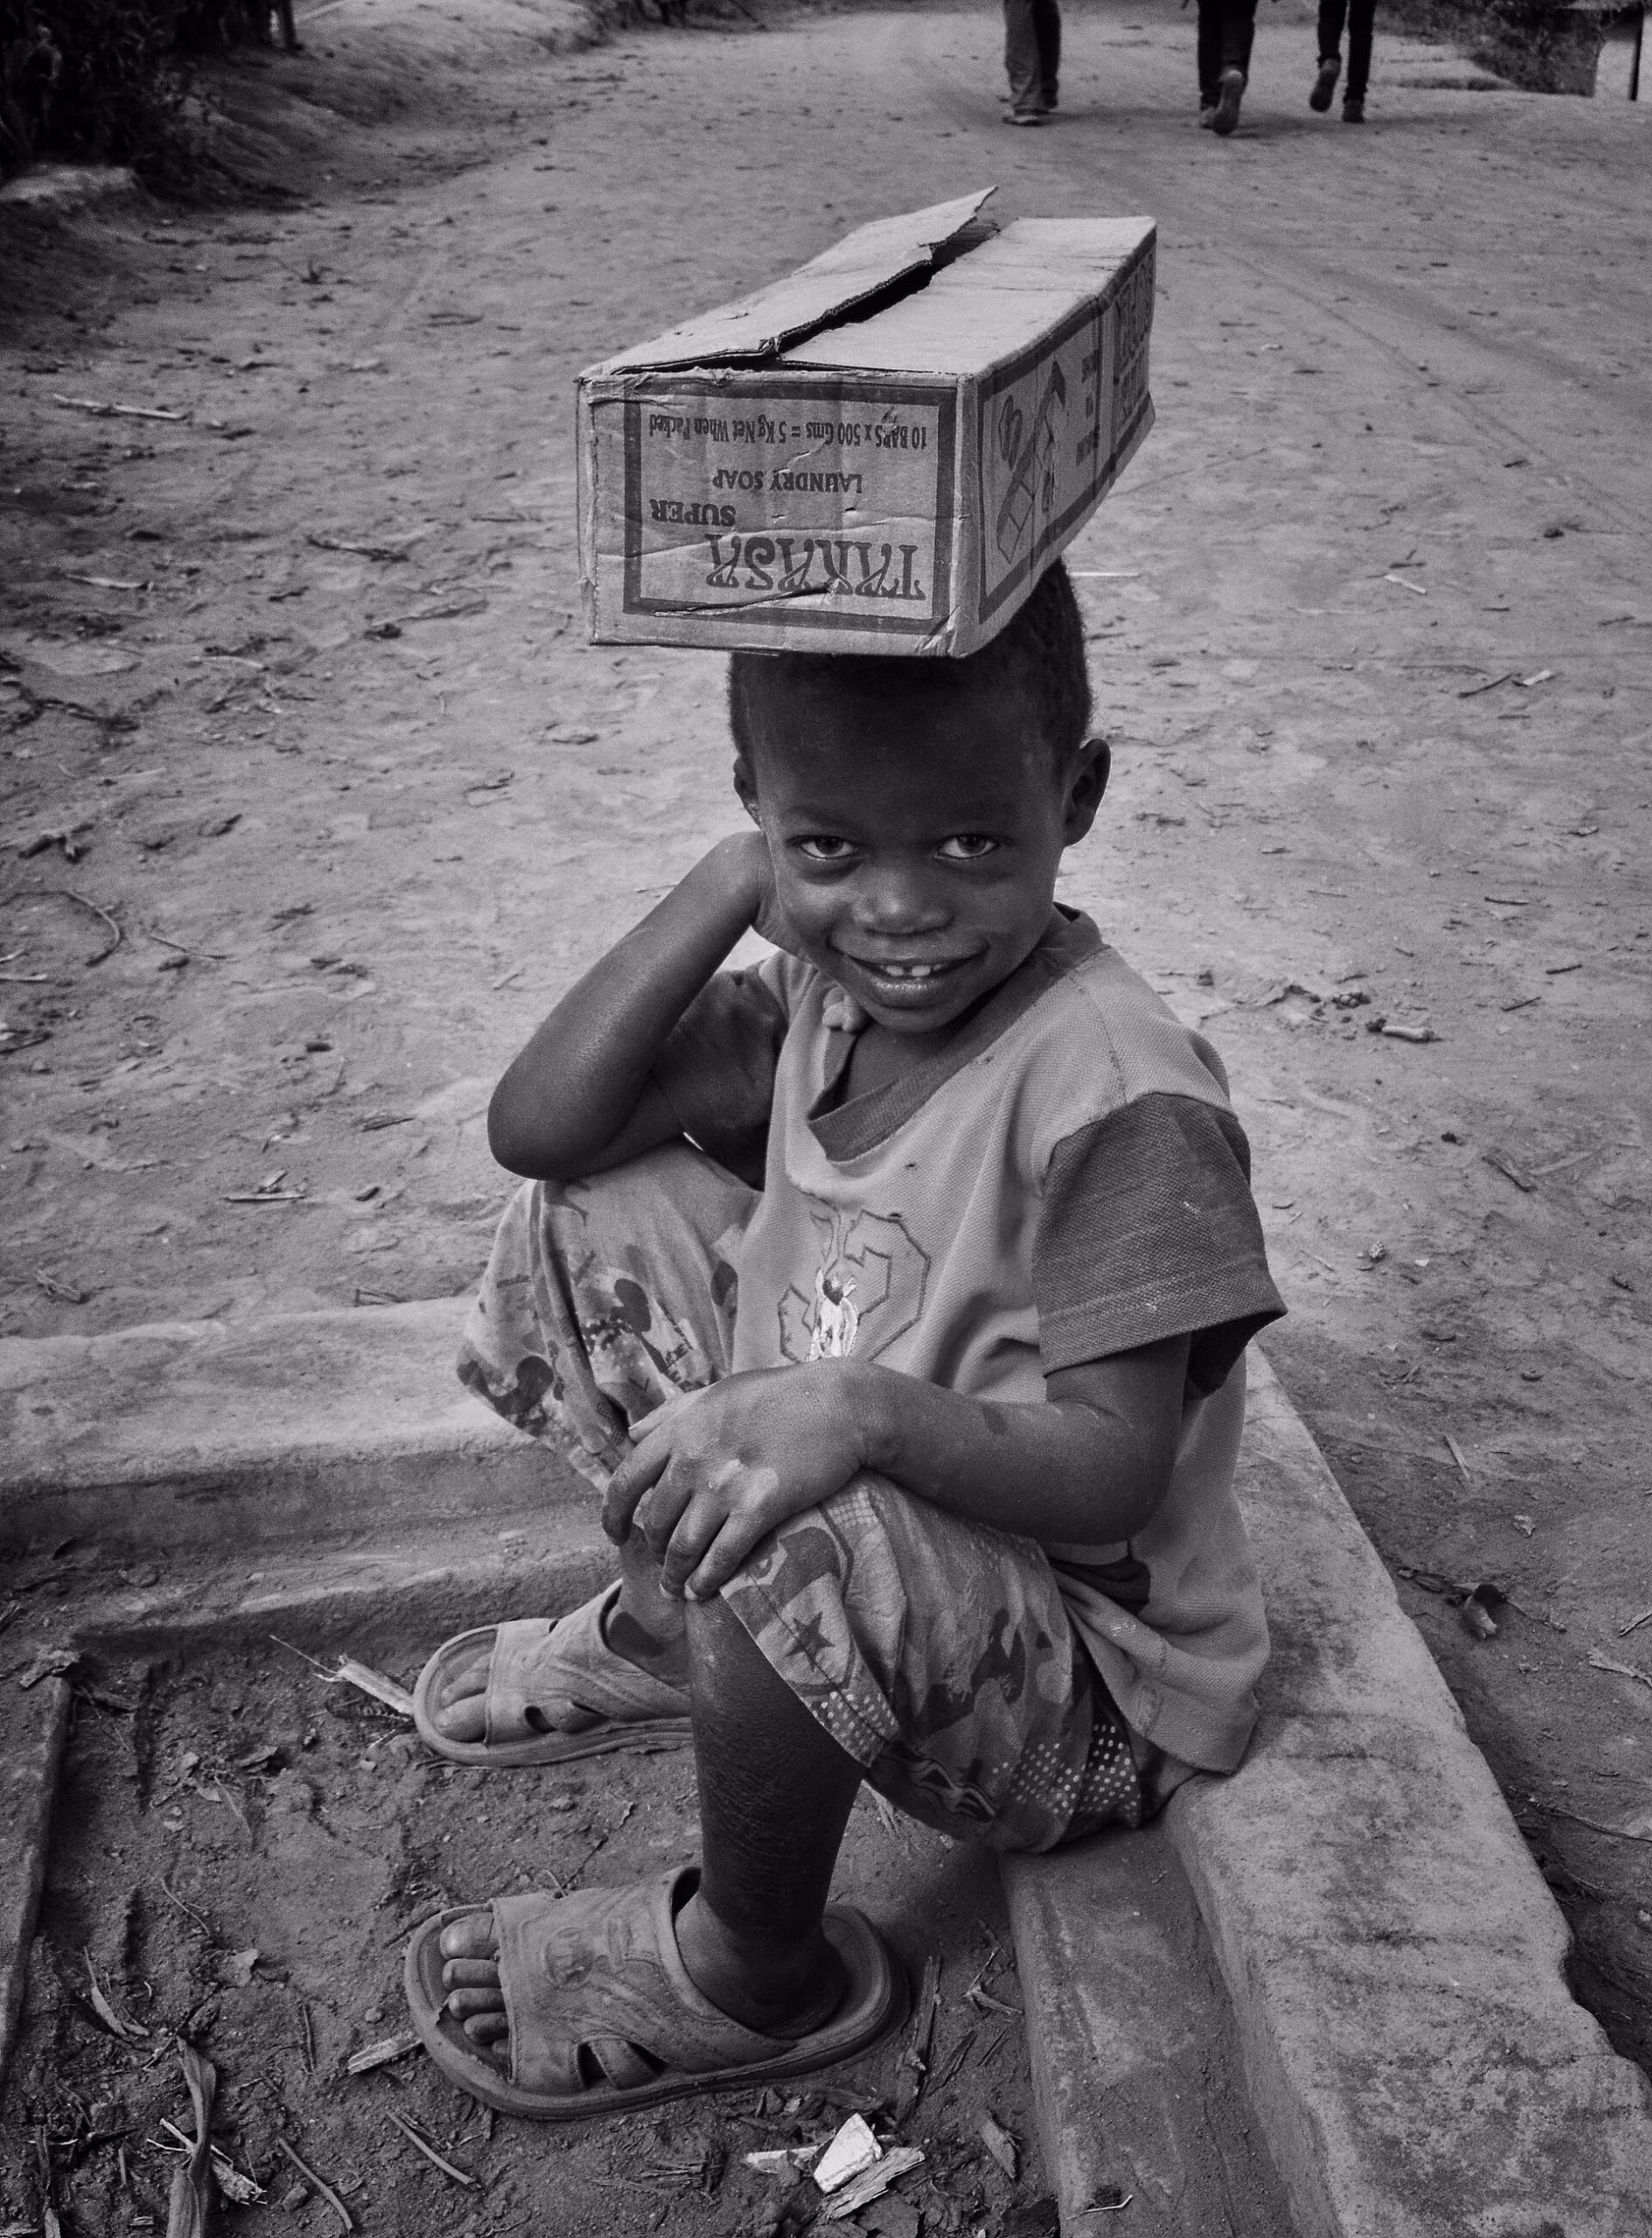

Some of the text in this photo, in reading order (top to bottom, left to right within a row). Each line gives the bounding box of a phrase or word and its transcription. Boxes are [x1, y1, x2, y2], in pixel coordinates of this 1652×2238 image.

[649, 414, 691, 440] Packed
[694, 418, 730, 442] When
[732, 420, 755, 443] Net
[758, 414, 774, 443] Kg
[779, 420, 787, 443] 5
[805, 421, 834, 446] Gms
[837, 423, 861, 447] 500
[912, 427, 927, 449] 10
[712, 469, 862, 494] LAUNDRY SOAP
[649, 499, 736, 527] SUPER
[705, 533, 927, 601] TAKASA
